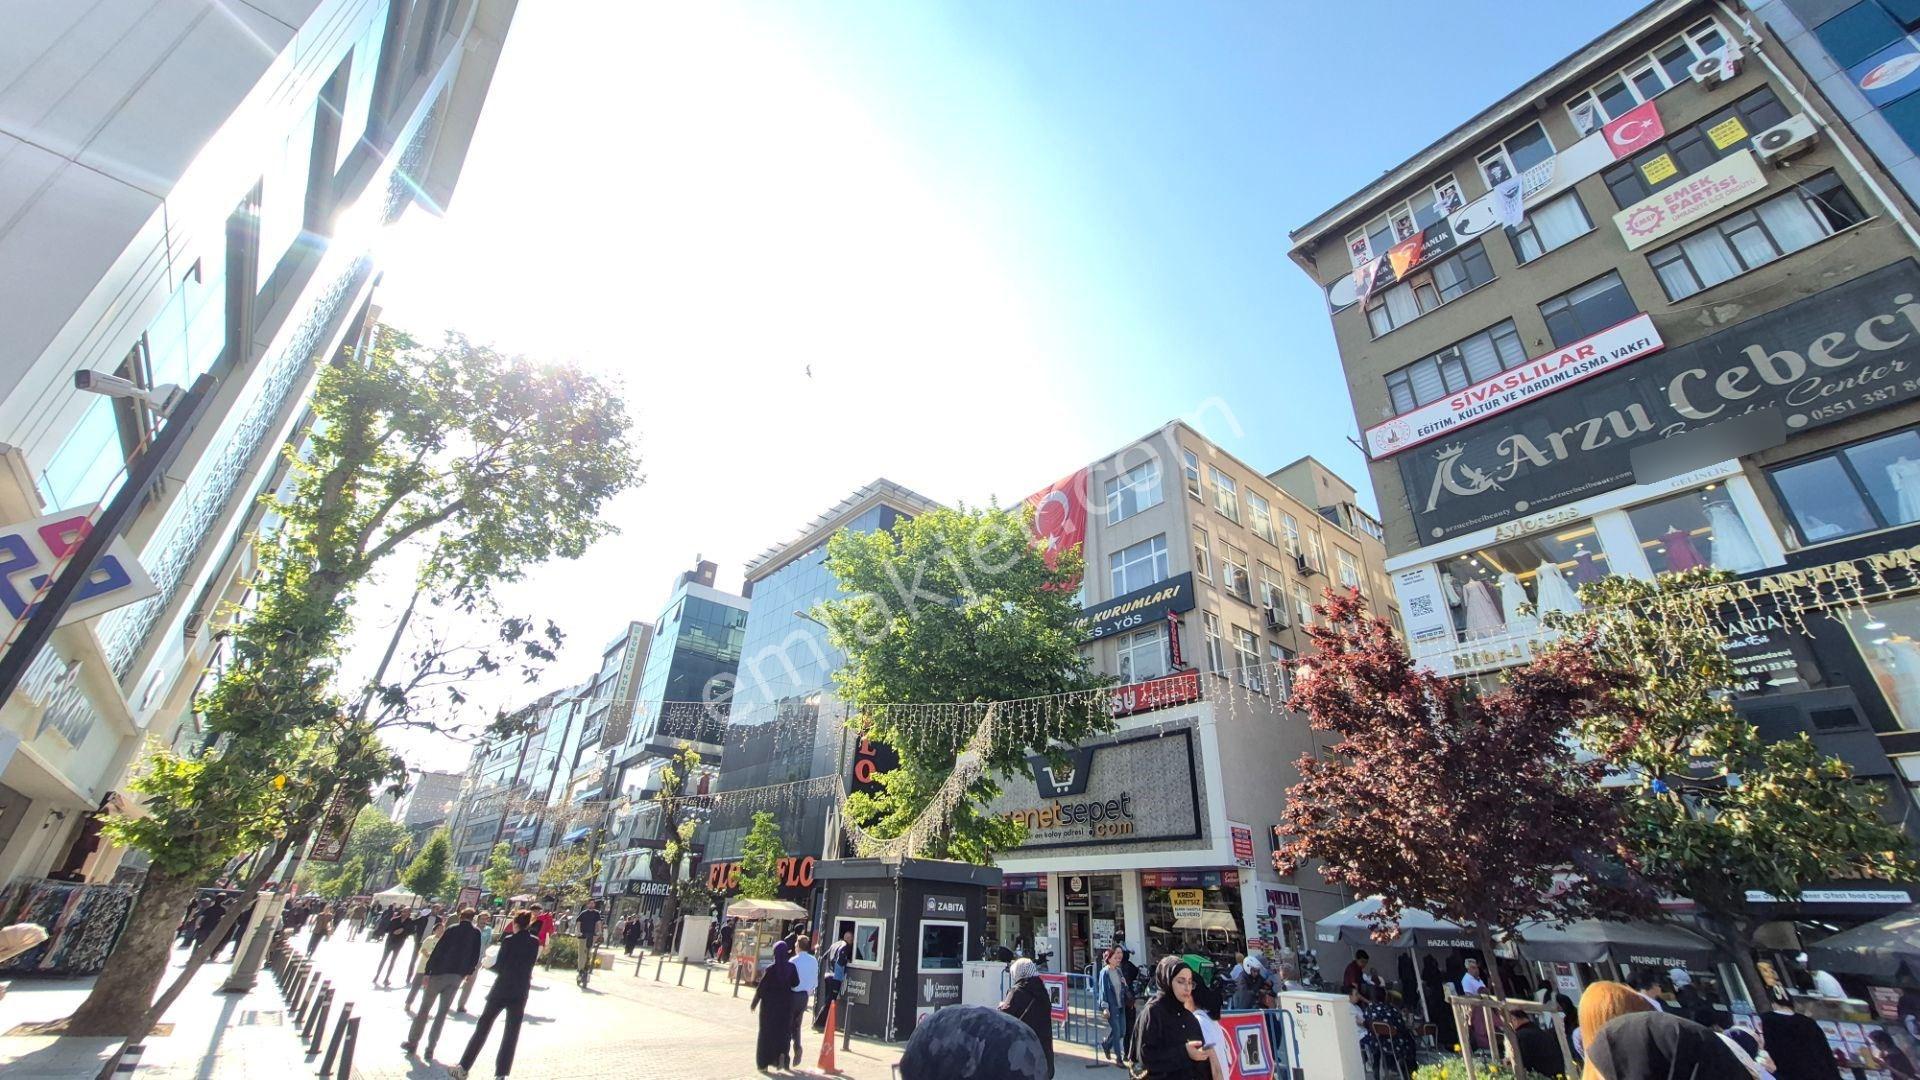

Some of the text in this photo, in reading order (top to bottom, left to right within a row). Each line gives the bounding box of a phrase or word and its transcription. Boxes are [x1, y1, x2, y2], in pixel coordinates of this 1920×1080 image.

[1664, 175, 1713, 205] EMEK
[1668, 175, 1737, 214] PARTİSİ
[1418, 419, 1456, 437] EĞİTİM,
[1458, 397, 1501, 420] KÜLTÜR
[1502, 390, 1519, 403] VE
[1521, 356, 1608, 397] YARDIMLAŞMA
[1611, 337, 1651, 360] VAKFI
[1450, 344, 1597, 412] SİVASLILAR
[1786, 360, 1913, 407] Center
[1811, 399, 1856, 421] 0551
[1864, 386, 1897, 405] 387
[1496, 403, 1655, 481] Arzu
[1093, 585, 1181, 622] KURUMLARI
[1114, 614, 1143, 630] YÖS
[775, 856, 816, 887] FLO
[854, 900, 877, 909] ZABITA
[937, 902, 964, 912] ZABITA
[1427, 939, 1474, 948] HAZAL BÖREK
[1630, 955, 1660, 965] MURAT
